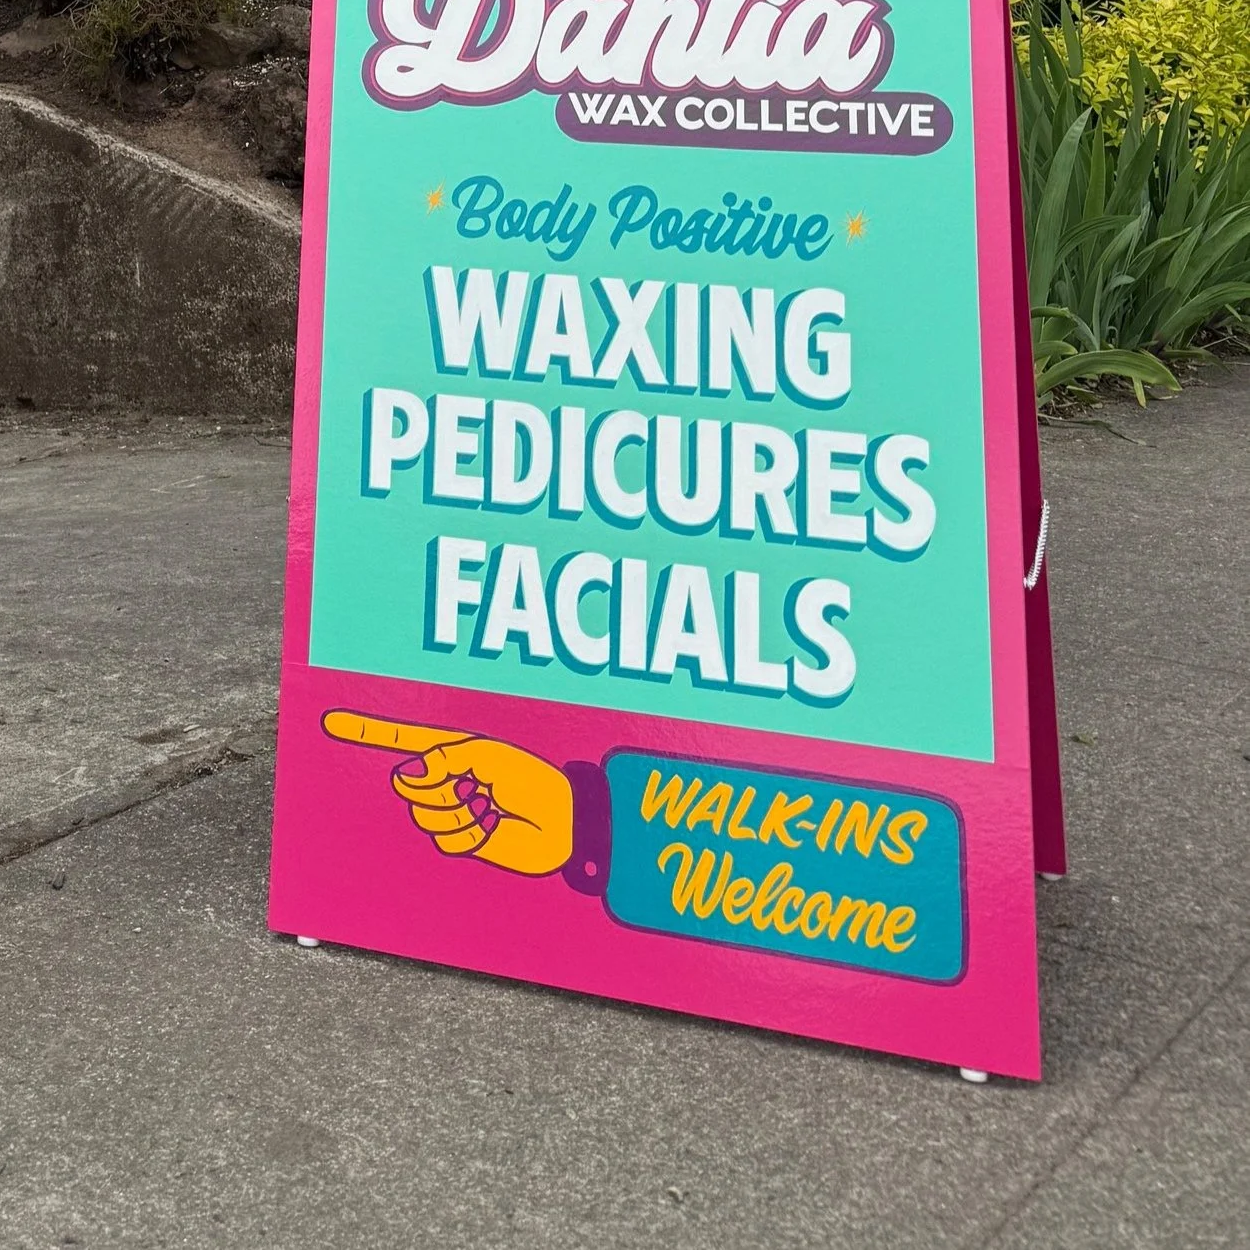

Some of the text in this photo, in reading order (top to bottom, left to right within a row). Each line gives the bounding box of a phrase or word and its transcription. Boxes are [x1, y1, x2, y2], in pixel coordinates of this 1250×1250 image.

[568, 92, 935, 137] WAX COLLECTIVE
[451, 175, 834, 263] Body Positive
[425, 265, 851, 410] WAXING
[361, 388, 936, 562] PEDICURES
[423, 536, 857, 709] FACIALS
[641, 771, 927, 864] WALK-INS
[658, 842, 918, 953] Welcome
